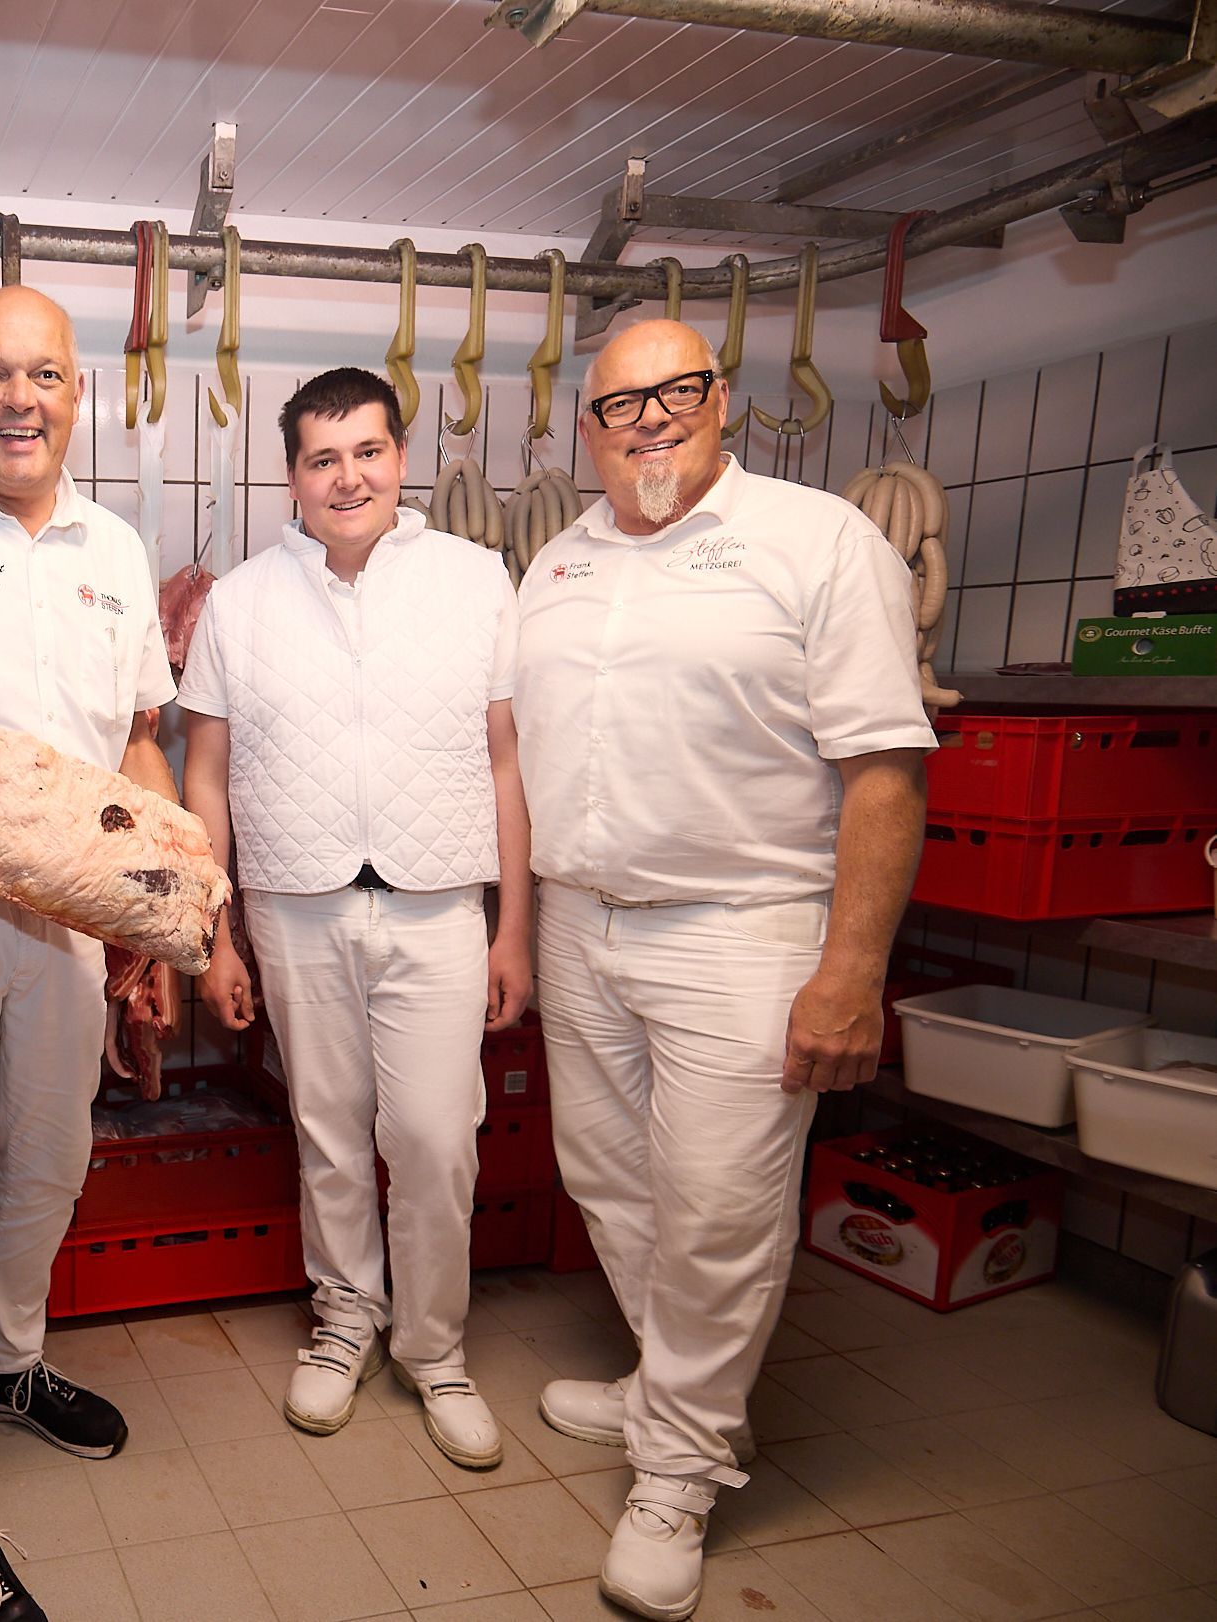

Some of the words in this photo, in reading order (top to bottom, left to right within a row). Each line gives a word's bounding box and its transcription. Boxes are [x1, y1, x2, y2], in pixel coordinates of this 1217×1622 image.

[666, 536, 746, 568] Steffen
[569, 560, 591, 570] Frank
[689, 560, 742, 570] METZGEREI
[566, 570, 594, 580] Steffen
[1104, 626, 1151, 638] Gourmet
[1178, 624, 1213, 635] Buffet
